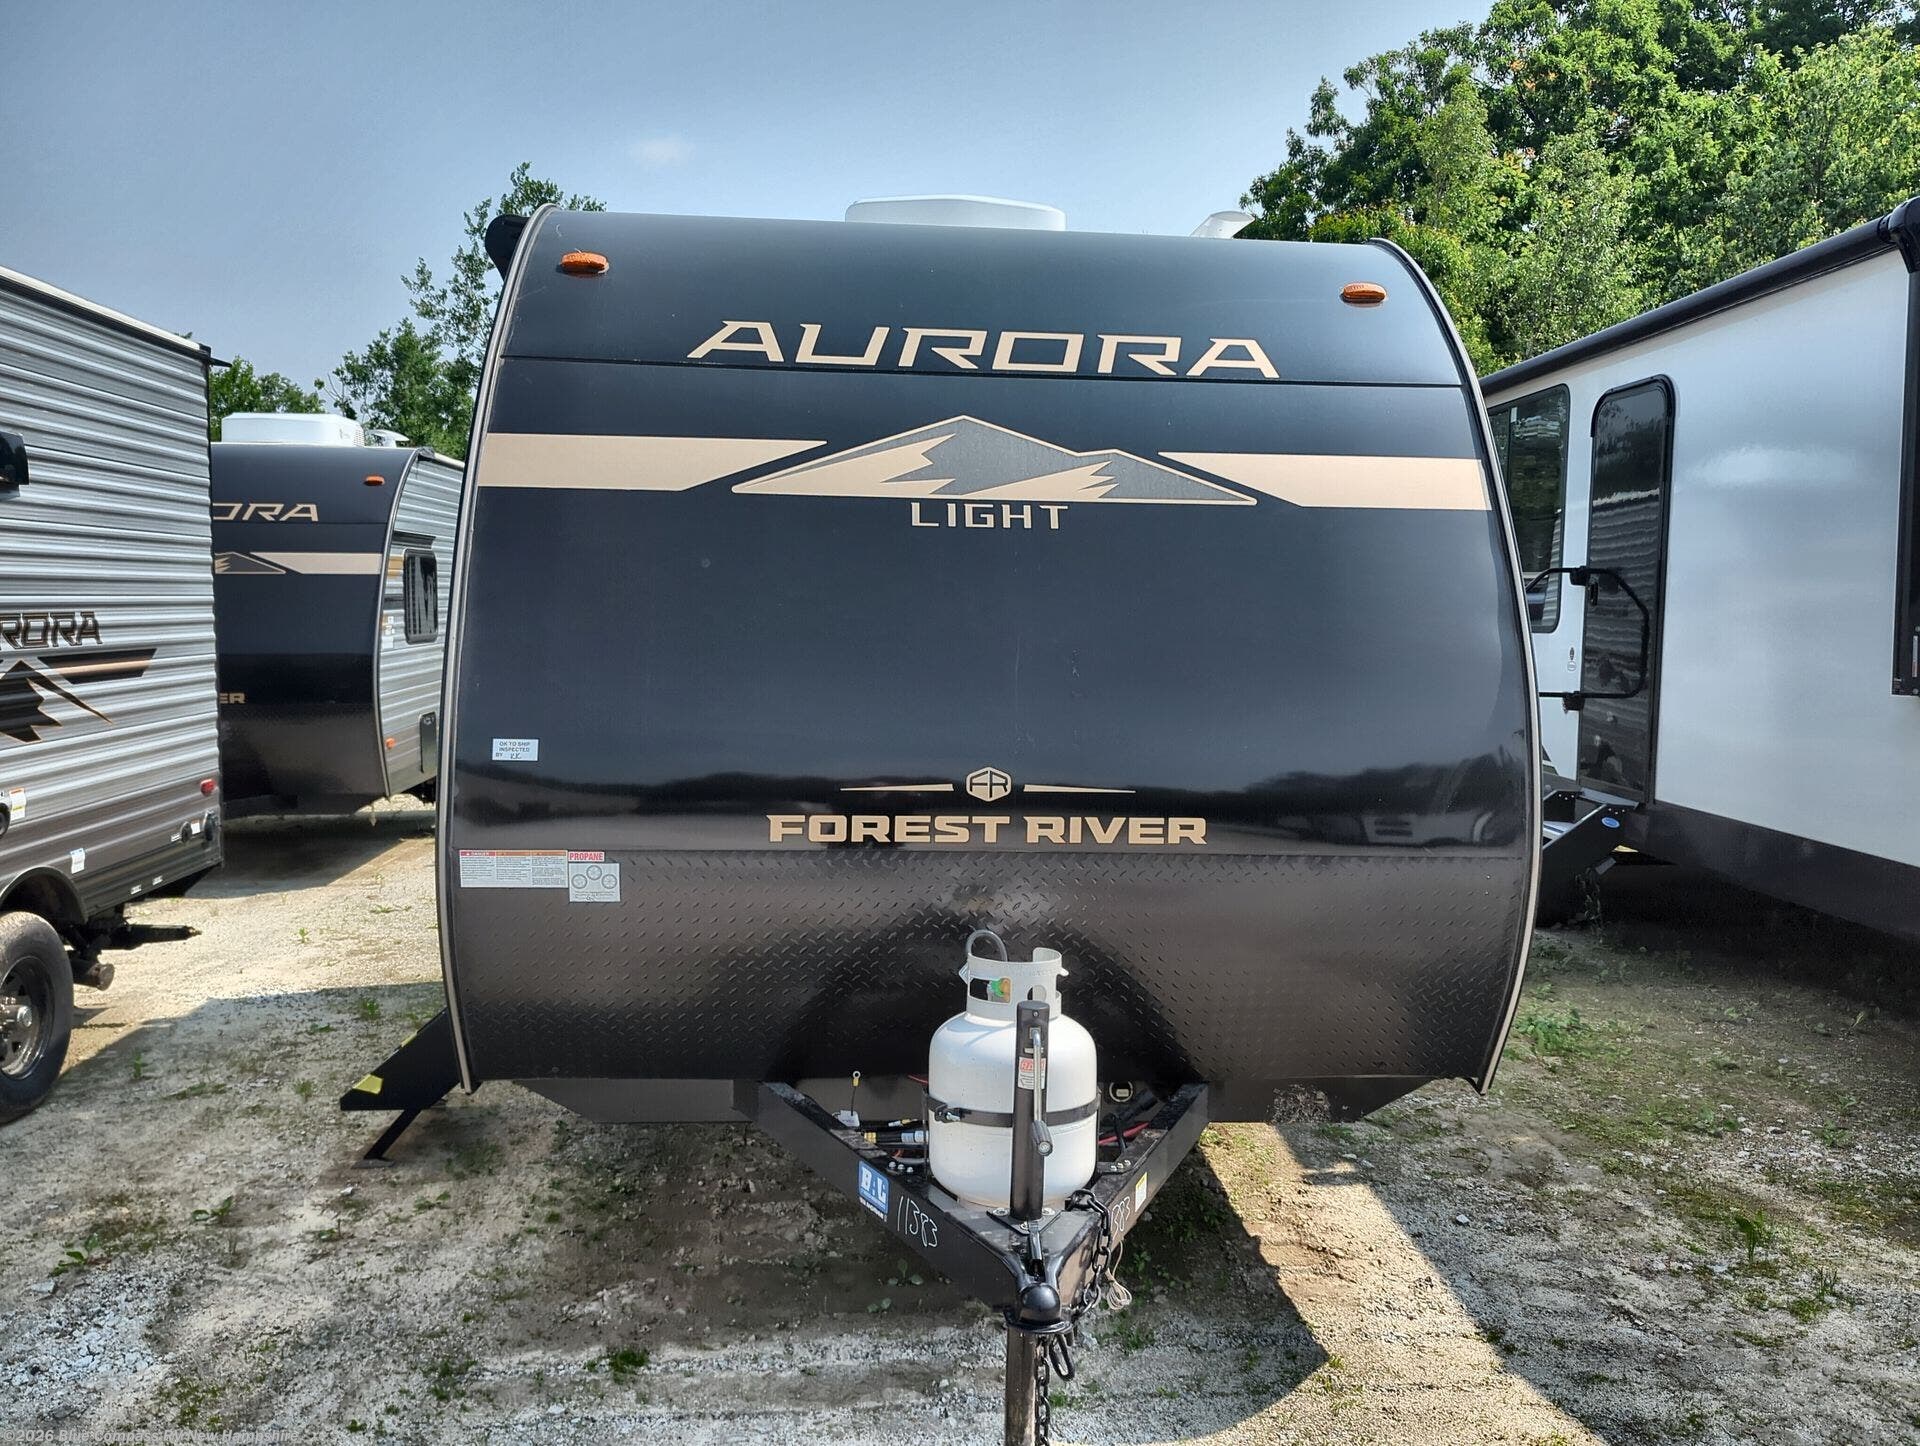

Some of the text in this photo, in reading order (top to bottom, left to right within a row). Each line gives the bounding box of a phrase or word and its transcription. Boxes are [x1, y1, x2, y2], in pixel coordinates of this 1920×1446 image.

[687, 320, 1280, 378] AURORA
[910, 501, 1069, 530] LIGHT
[766, 814, 1208, 844] FOREST RIVER
[569, 852, 604, 861] PROPANE
